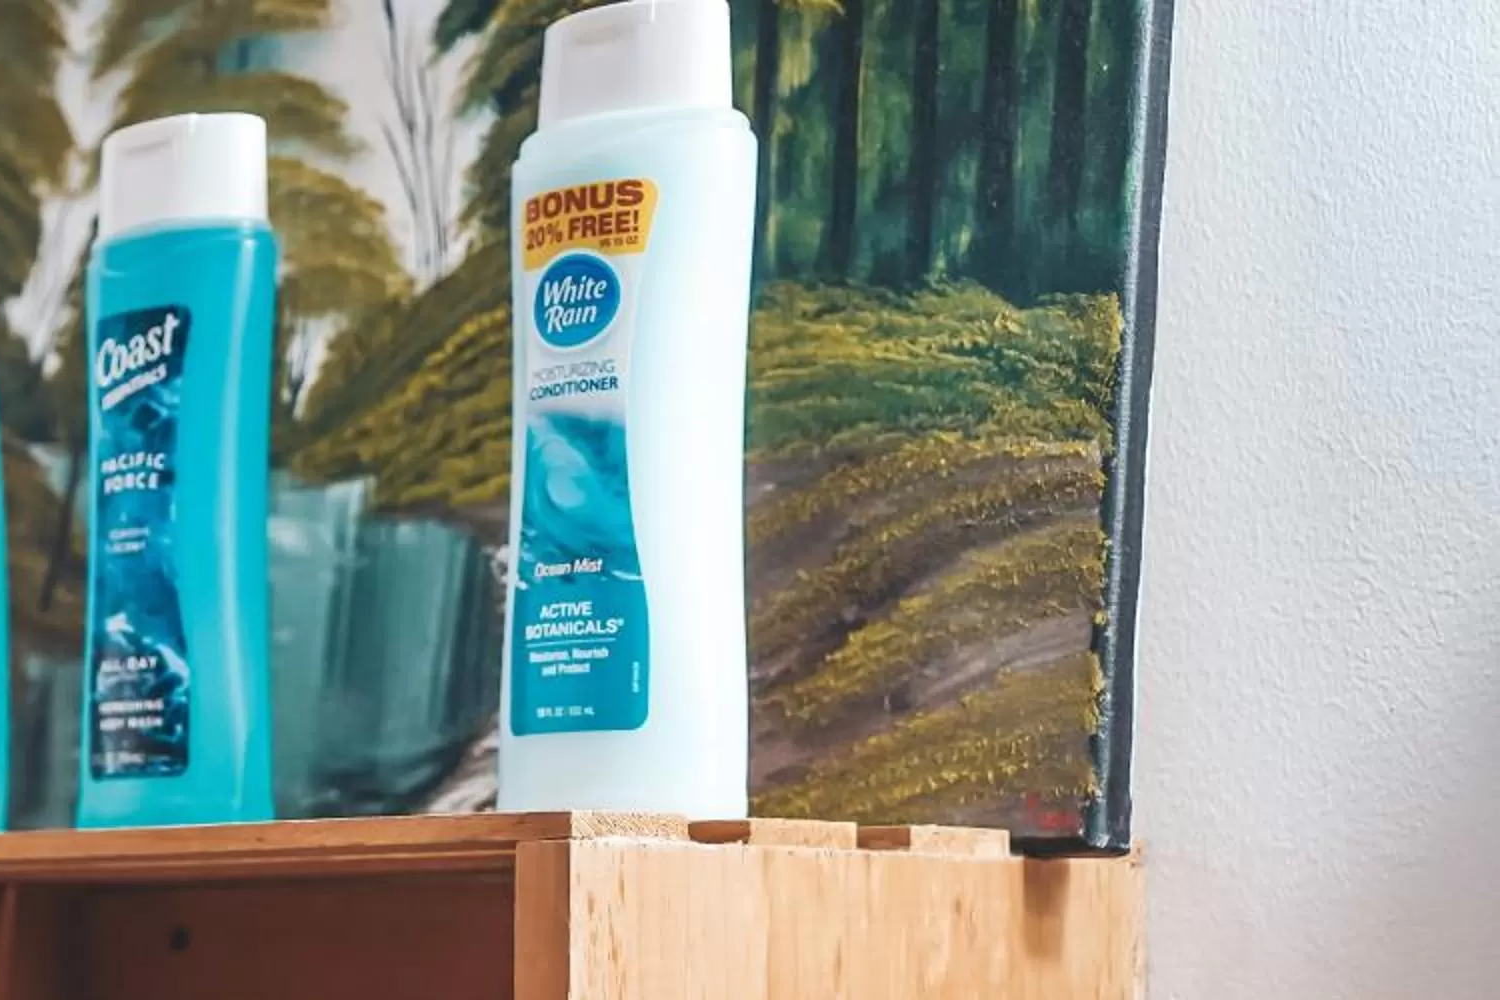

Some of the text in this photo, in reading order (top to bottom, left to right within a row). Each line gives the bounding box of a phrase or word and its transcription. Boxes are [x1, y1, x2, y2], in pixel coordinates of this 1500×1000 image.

[526, 179, 645, 224] BONUS
[526, 209, 640, 251] 20% FREE!
[543, 274, 608, 308] White
[544, 304, 598, 335] Rain
[94, 311, 180, 388] Coast
[530, 375, 619, 401] CONDITIONER
[100, 451, 167, 474] PACIFIC
[103, 472, 160, 496] FORCE
[574, 557, 603, 573] Mist
[540, 601, 592, 620] ACTIVE
